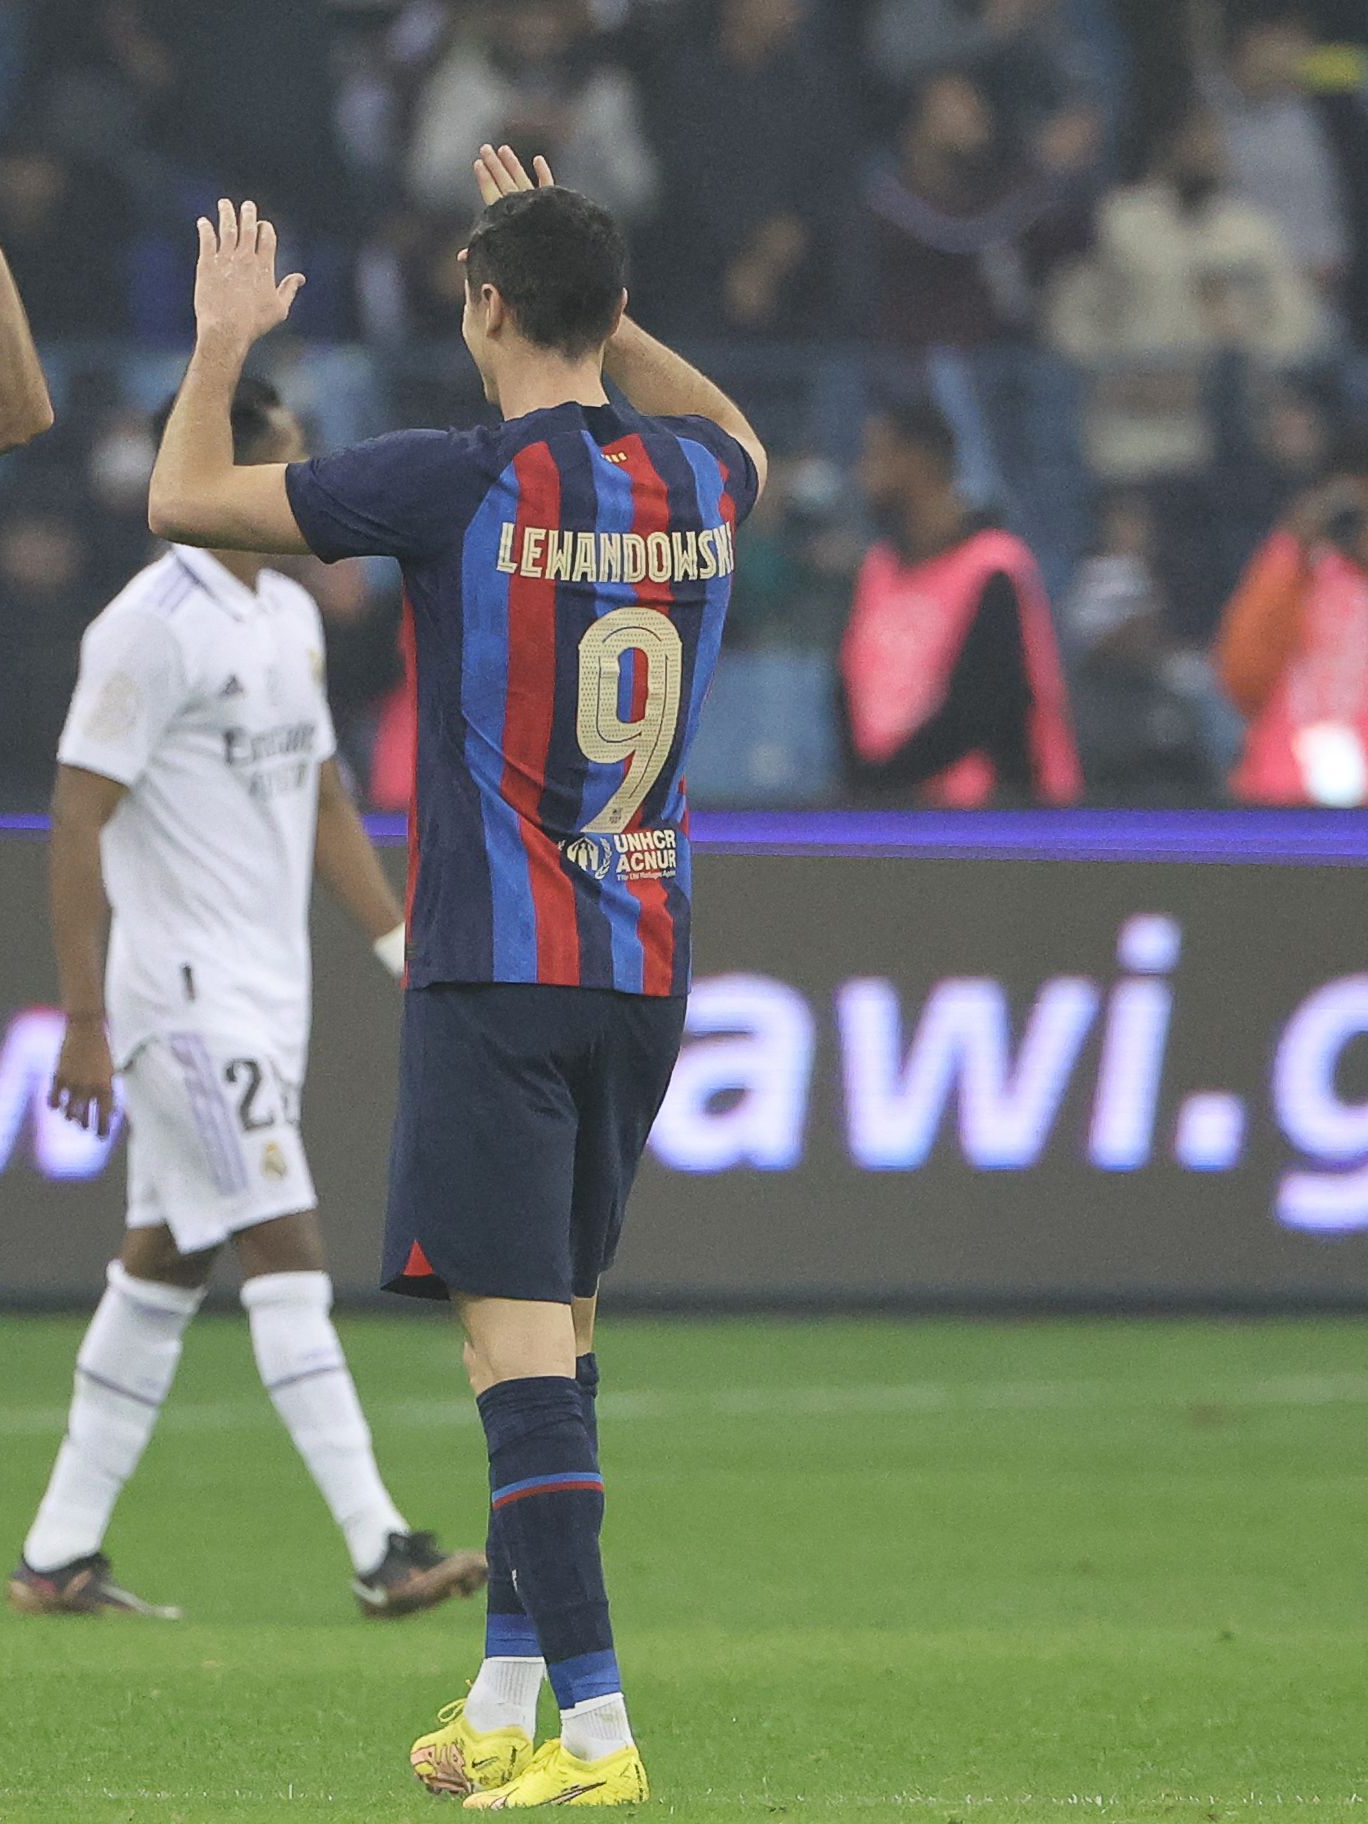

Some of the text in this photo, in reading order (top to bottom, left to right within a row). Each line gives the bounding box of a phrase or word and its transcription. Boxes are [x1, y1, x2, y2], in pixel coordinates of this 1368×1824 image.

[577, 607, 683, 833] 9
[613, 829, 676, 854] UNHCR
[615, 849, 676, 873] ACNUR
